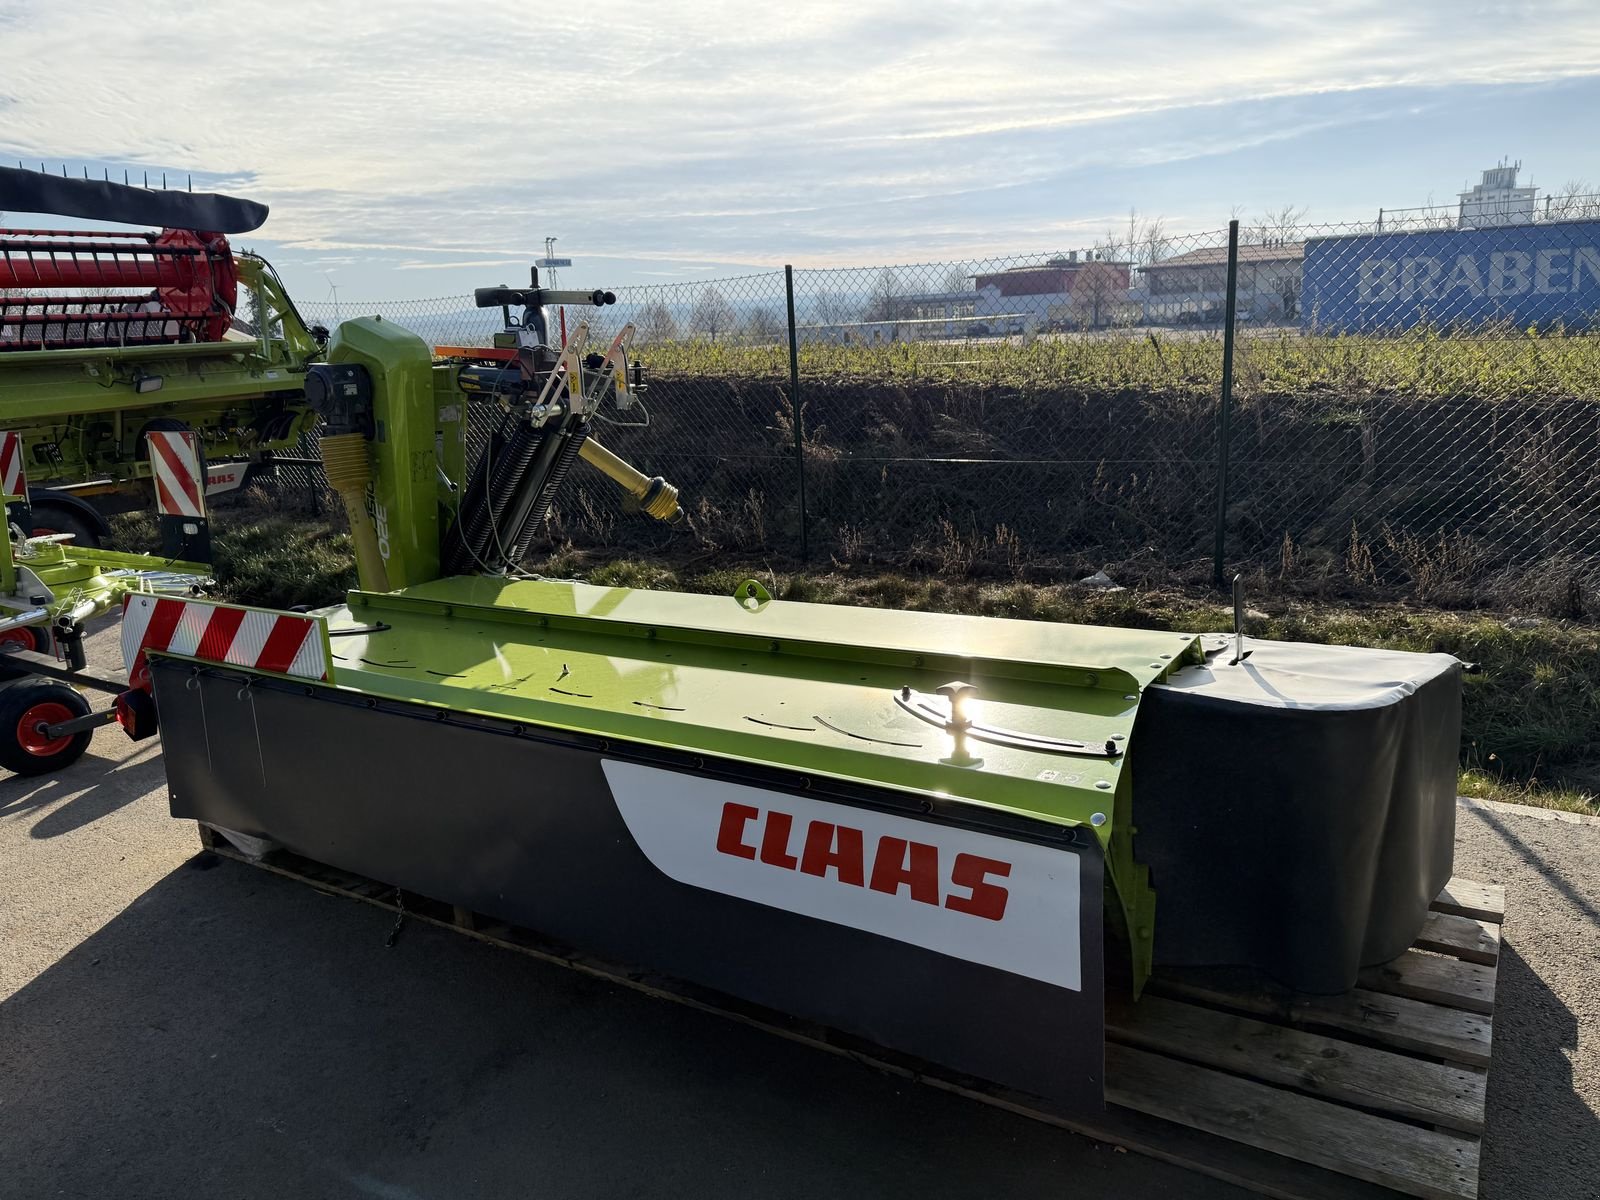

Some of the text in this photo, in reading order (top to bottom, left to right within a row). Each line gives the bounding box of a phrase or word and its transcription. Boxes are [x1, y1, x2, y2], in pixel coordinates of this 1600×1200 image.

[208, 473, 235, 485] AAS
[376, 503, 390, 559] 320
[716, 801, 1012, 921] CLAAS
